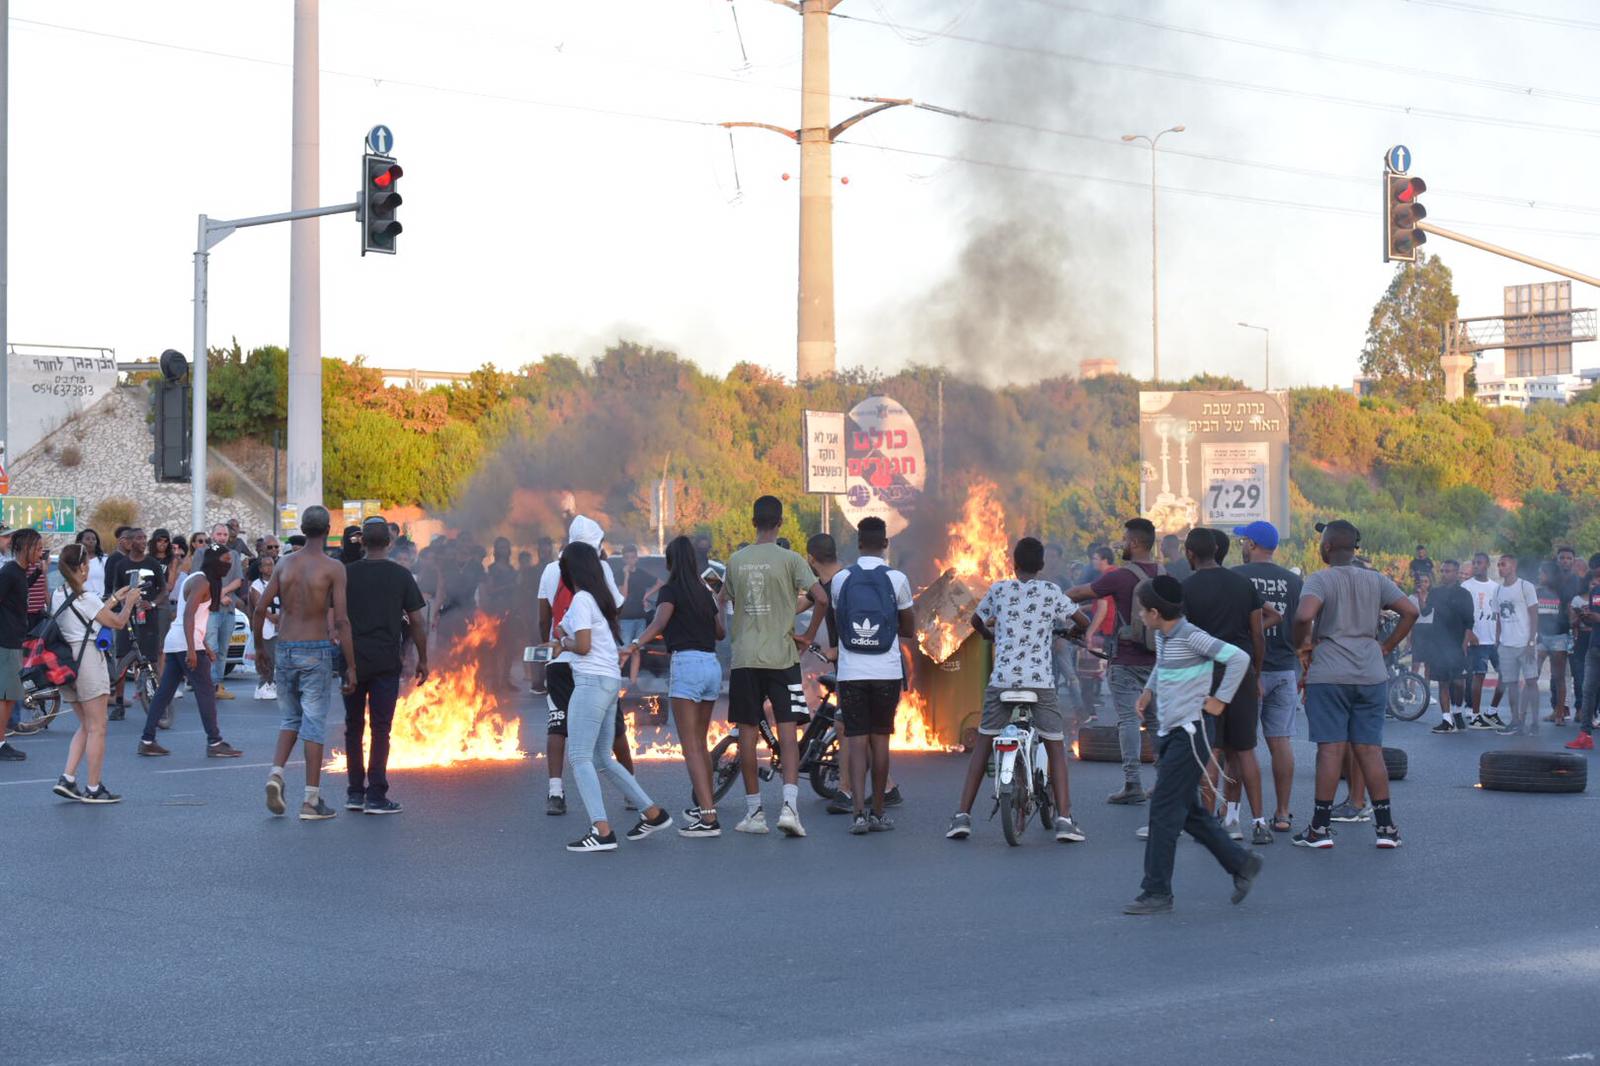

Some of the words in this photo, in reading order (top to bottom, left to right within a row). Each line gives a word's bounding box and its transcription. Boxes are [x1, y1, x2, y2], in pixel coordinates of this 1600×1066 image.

[33, 357, 63, 372] לחורף
[67, 356, 93, 372] גגך
[94, 359, 114, 372] הכן
[32, 383, 94, 397] 0546373813
[1202, 402, 1232, 415] שבת
[1236, 402, 1265, 415] נרות
[1187, 419, 1219, 432] הבית
[1224, 415, 1244, 432] של
[1249, 418, 1280, 432] האור
[814, 431, 825, 443] לא
[826, 432, 839, 444] אני
[853, 427, 908, 449] כולם
[1209, 484, 1261, 509] 7:29
[851, 637, 879, 646] adidas
